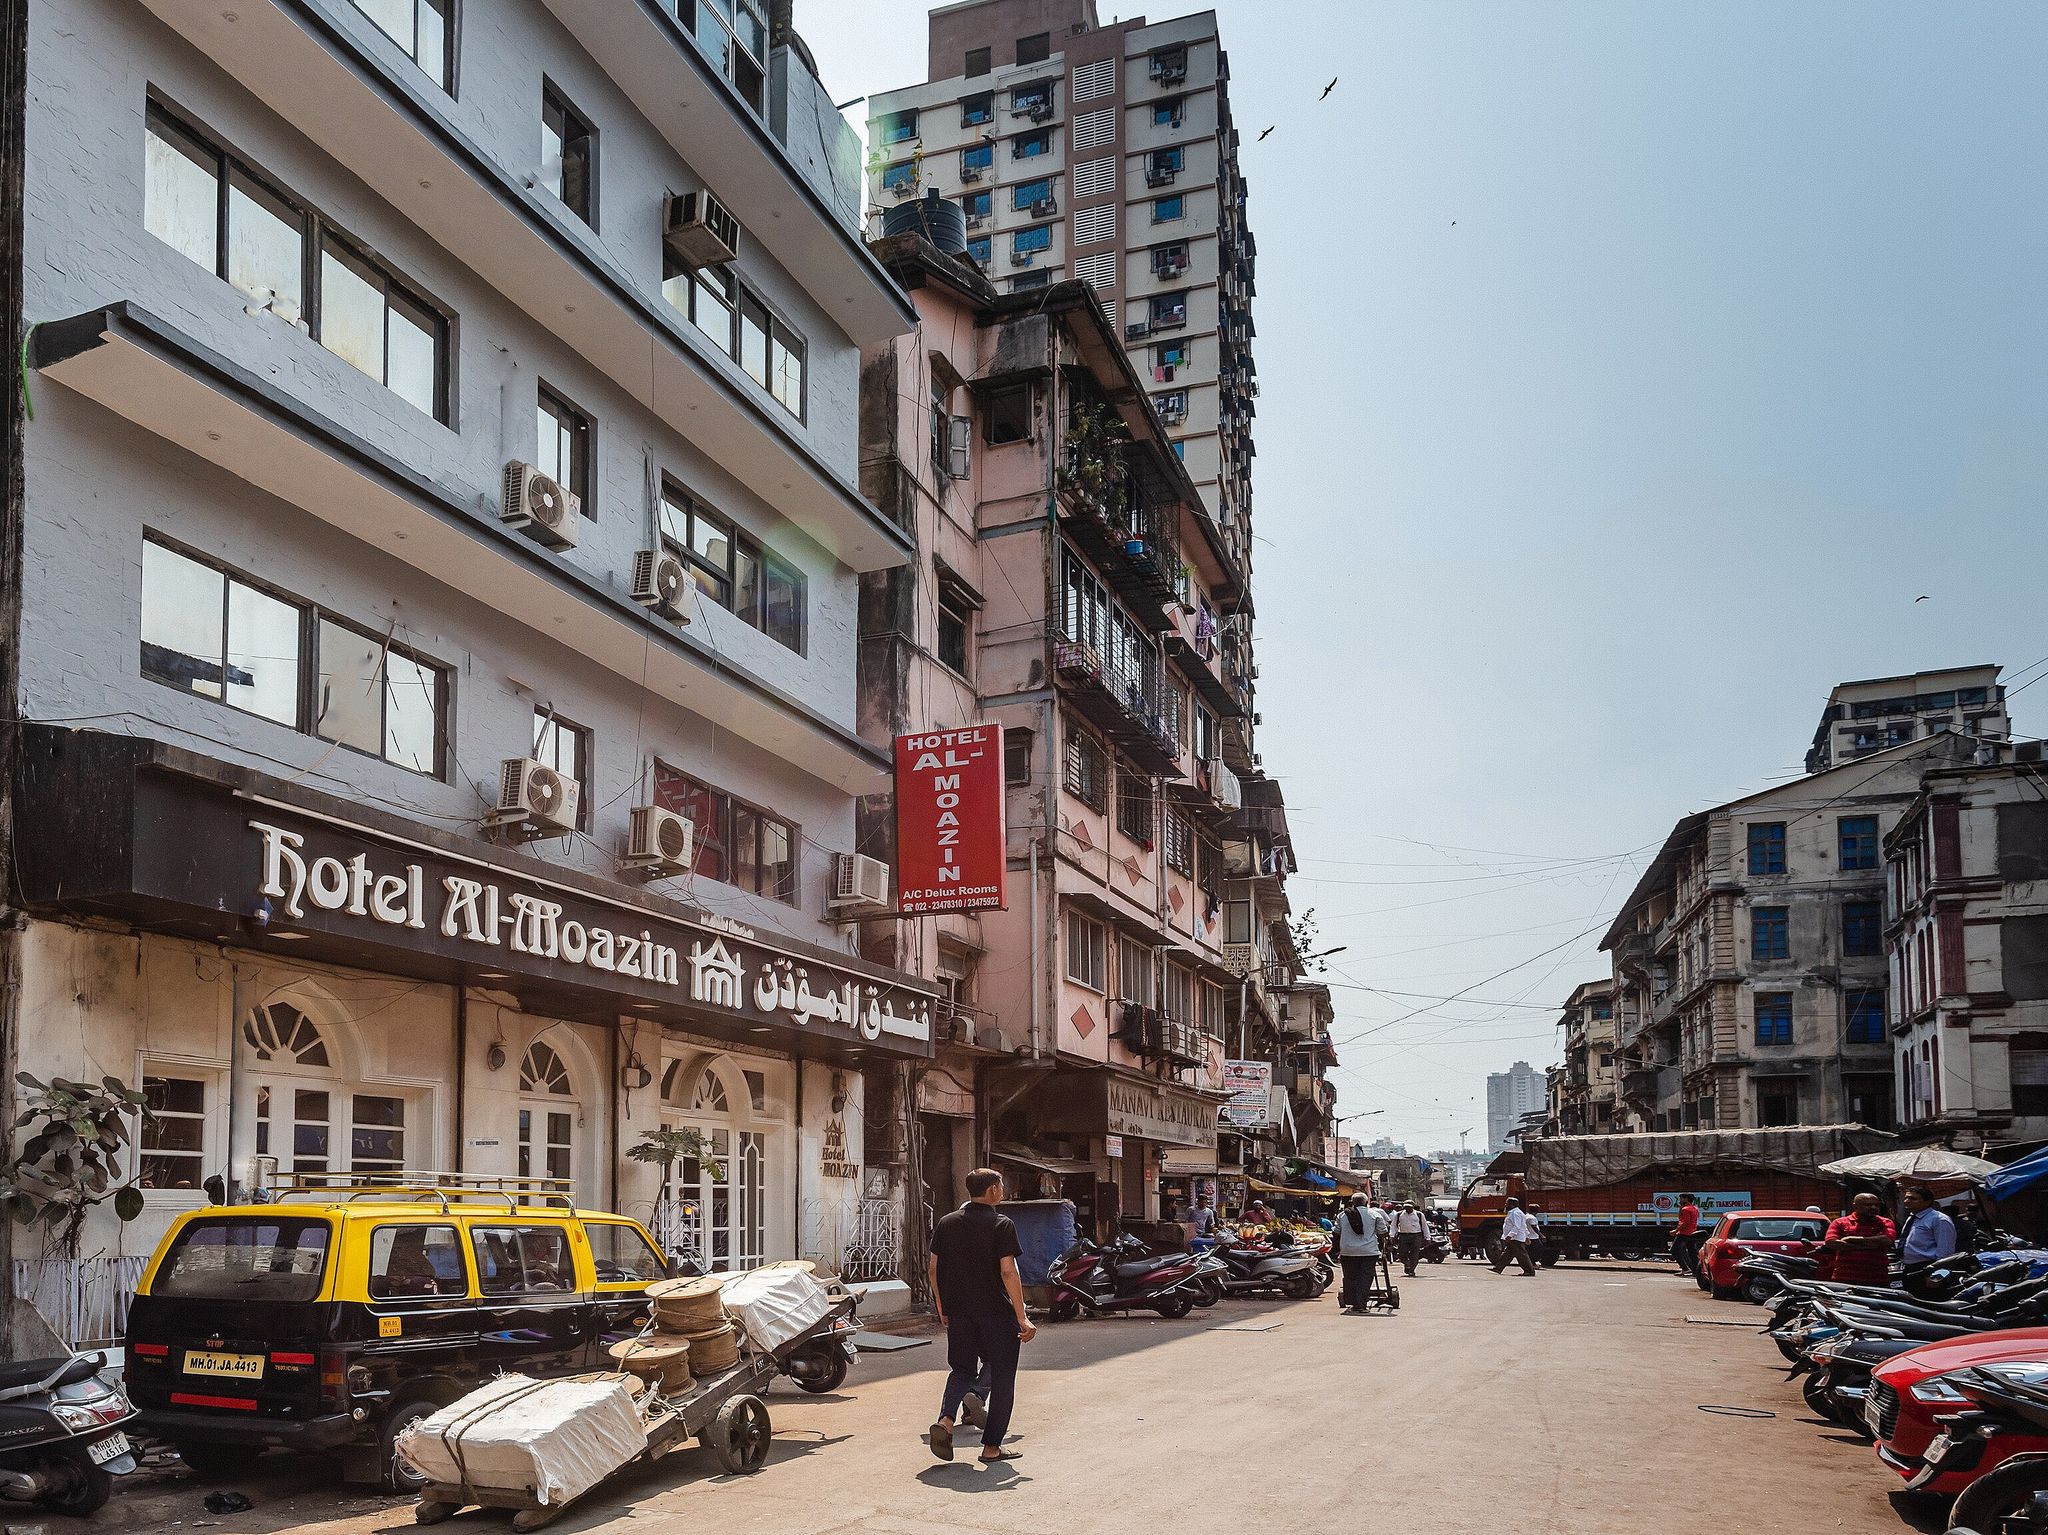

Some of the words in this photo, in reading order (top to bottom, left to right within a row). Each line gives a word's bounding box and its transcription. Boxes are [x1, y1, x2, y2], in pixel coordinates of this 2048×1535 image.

[908, 729, 987, 751] HOTEL
[934, 774, 961, 882] MOAZIN
[903, 890, 922, 899] A/C
[925, 888, 956, 898] Delux
[958, 886, 998, 895] Rooms
[248, 819, 426, 929] Hotel
[441, 876, 680, 987] Al-Moazin
[915, 902, 927, 911] 022
[861, 985, 930, 1041] فندق
[821, 1147, 845, 1161] Hotel
[205, 1340, 225, 1348] STOP
[190, 1357, 257, 1373] MH.01.JA.4413
